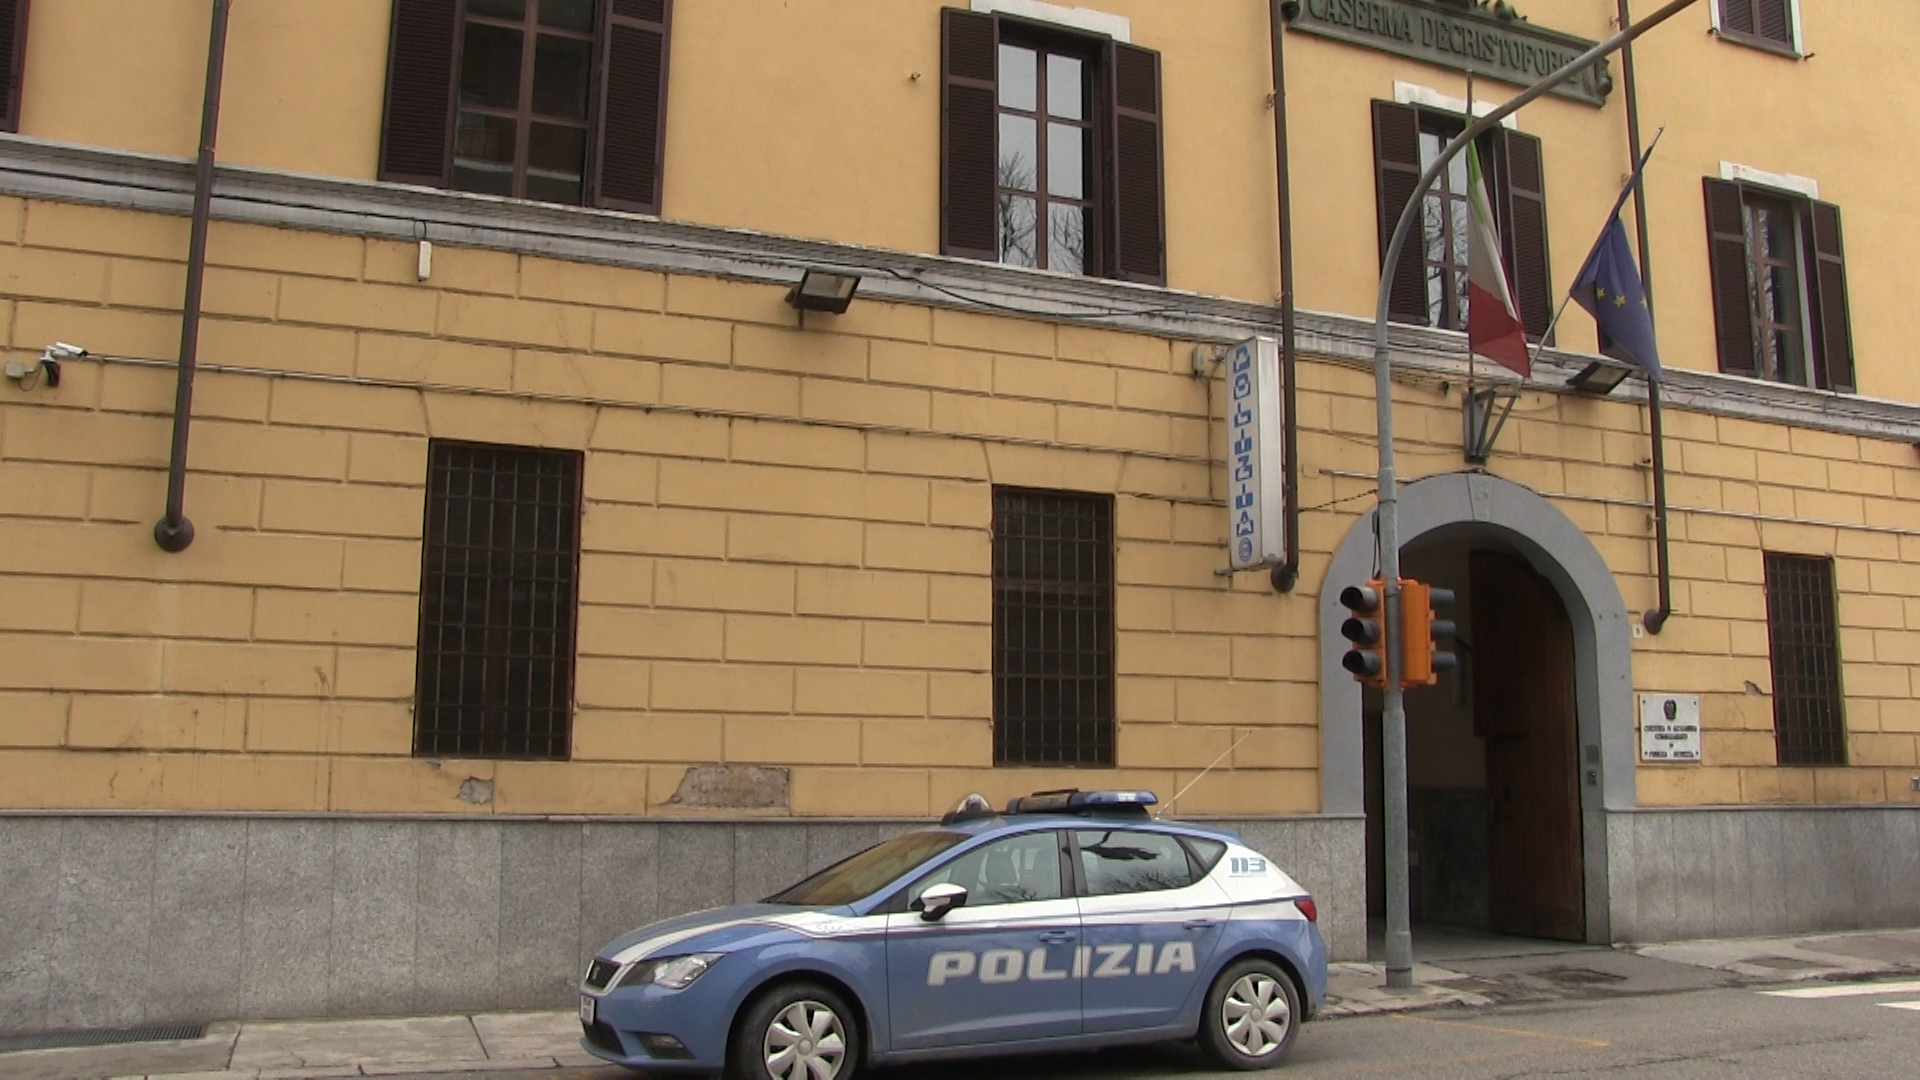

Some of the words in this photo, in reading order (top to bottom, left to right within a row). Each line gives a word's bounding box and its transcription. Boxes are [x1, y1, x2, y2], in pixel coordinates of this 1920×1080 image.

[1308, 0, 1413, 43] CASERMA
[1233, 346, 1254, 537] POLIZIA
[1230, 857, 1267, 874] 113
[927, 941, 1196, 987] POLIZIA
